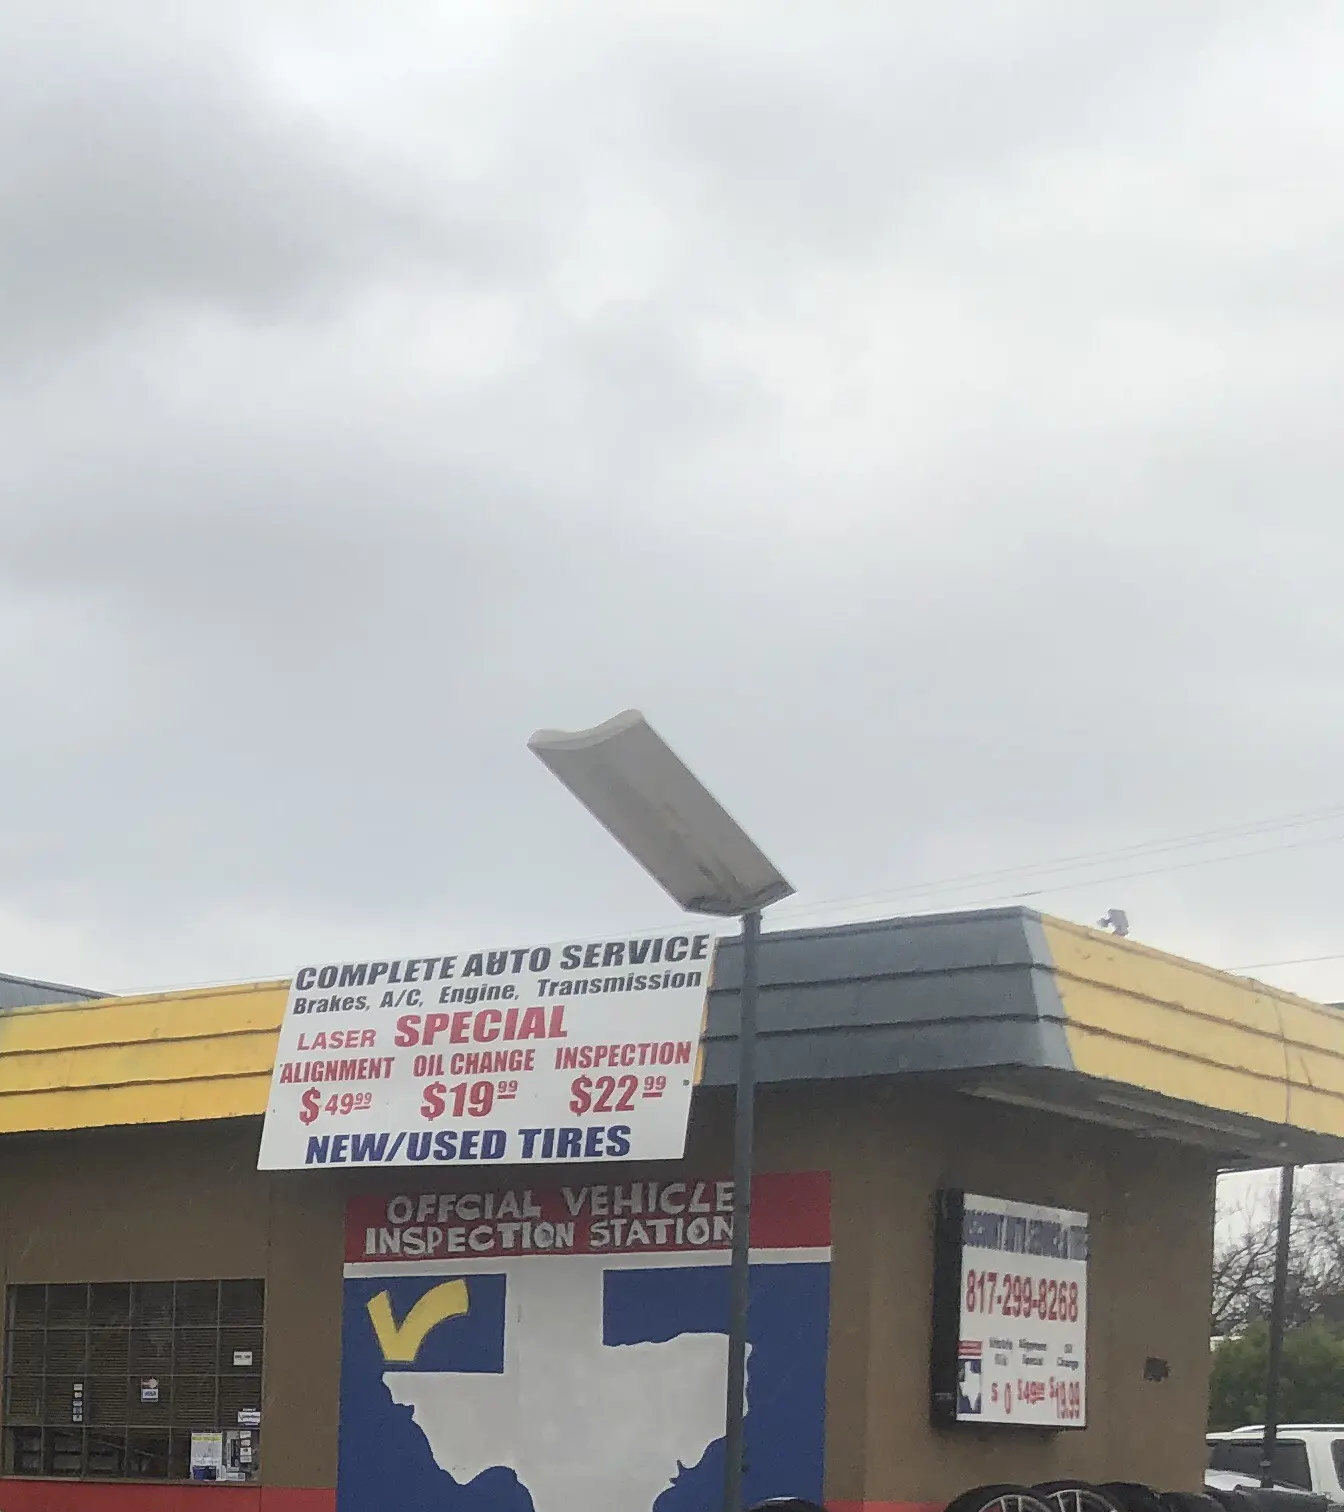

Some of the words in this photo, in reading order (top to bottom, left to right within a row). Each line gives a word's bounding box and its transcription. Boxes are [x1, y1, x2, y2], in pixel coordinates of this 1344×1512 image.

[296, 956, 457, 991] COMPLETE
[462, 947, 551, 978] AUTO
[560, 934, 711, 971] SERVICE
[293, 994, 370, 1015] Brakes,
[380, 990, 424, 1008] A/C,
[438, 983, 519, 1005] Engine,
[537, 971, 702, 998] Transmission
[297, 1029, 376, 1051] LASER
[394, 1006, 567, 1048] SPECIAL
[280, 1056, 395, 1084] ALIGNMENT
[413, 1054, 444, 1077] OIL
[450, 1049, 535, 1074] CHANGE
[554, 1041, 692, 1070] INSPECTION
[305, 1130, 507, 1165] NEW/USED
[518, 1125, 631, 1158] TIRES
[562, 1181, 735, 1216] VEHICLE
[364, 1221, 575, 1255] INSPECTION
[590, 1216, 734, 1247] STATION
[965, 1269, 1079, 1322] 817-299-8268
